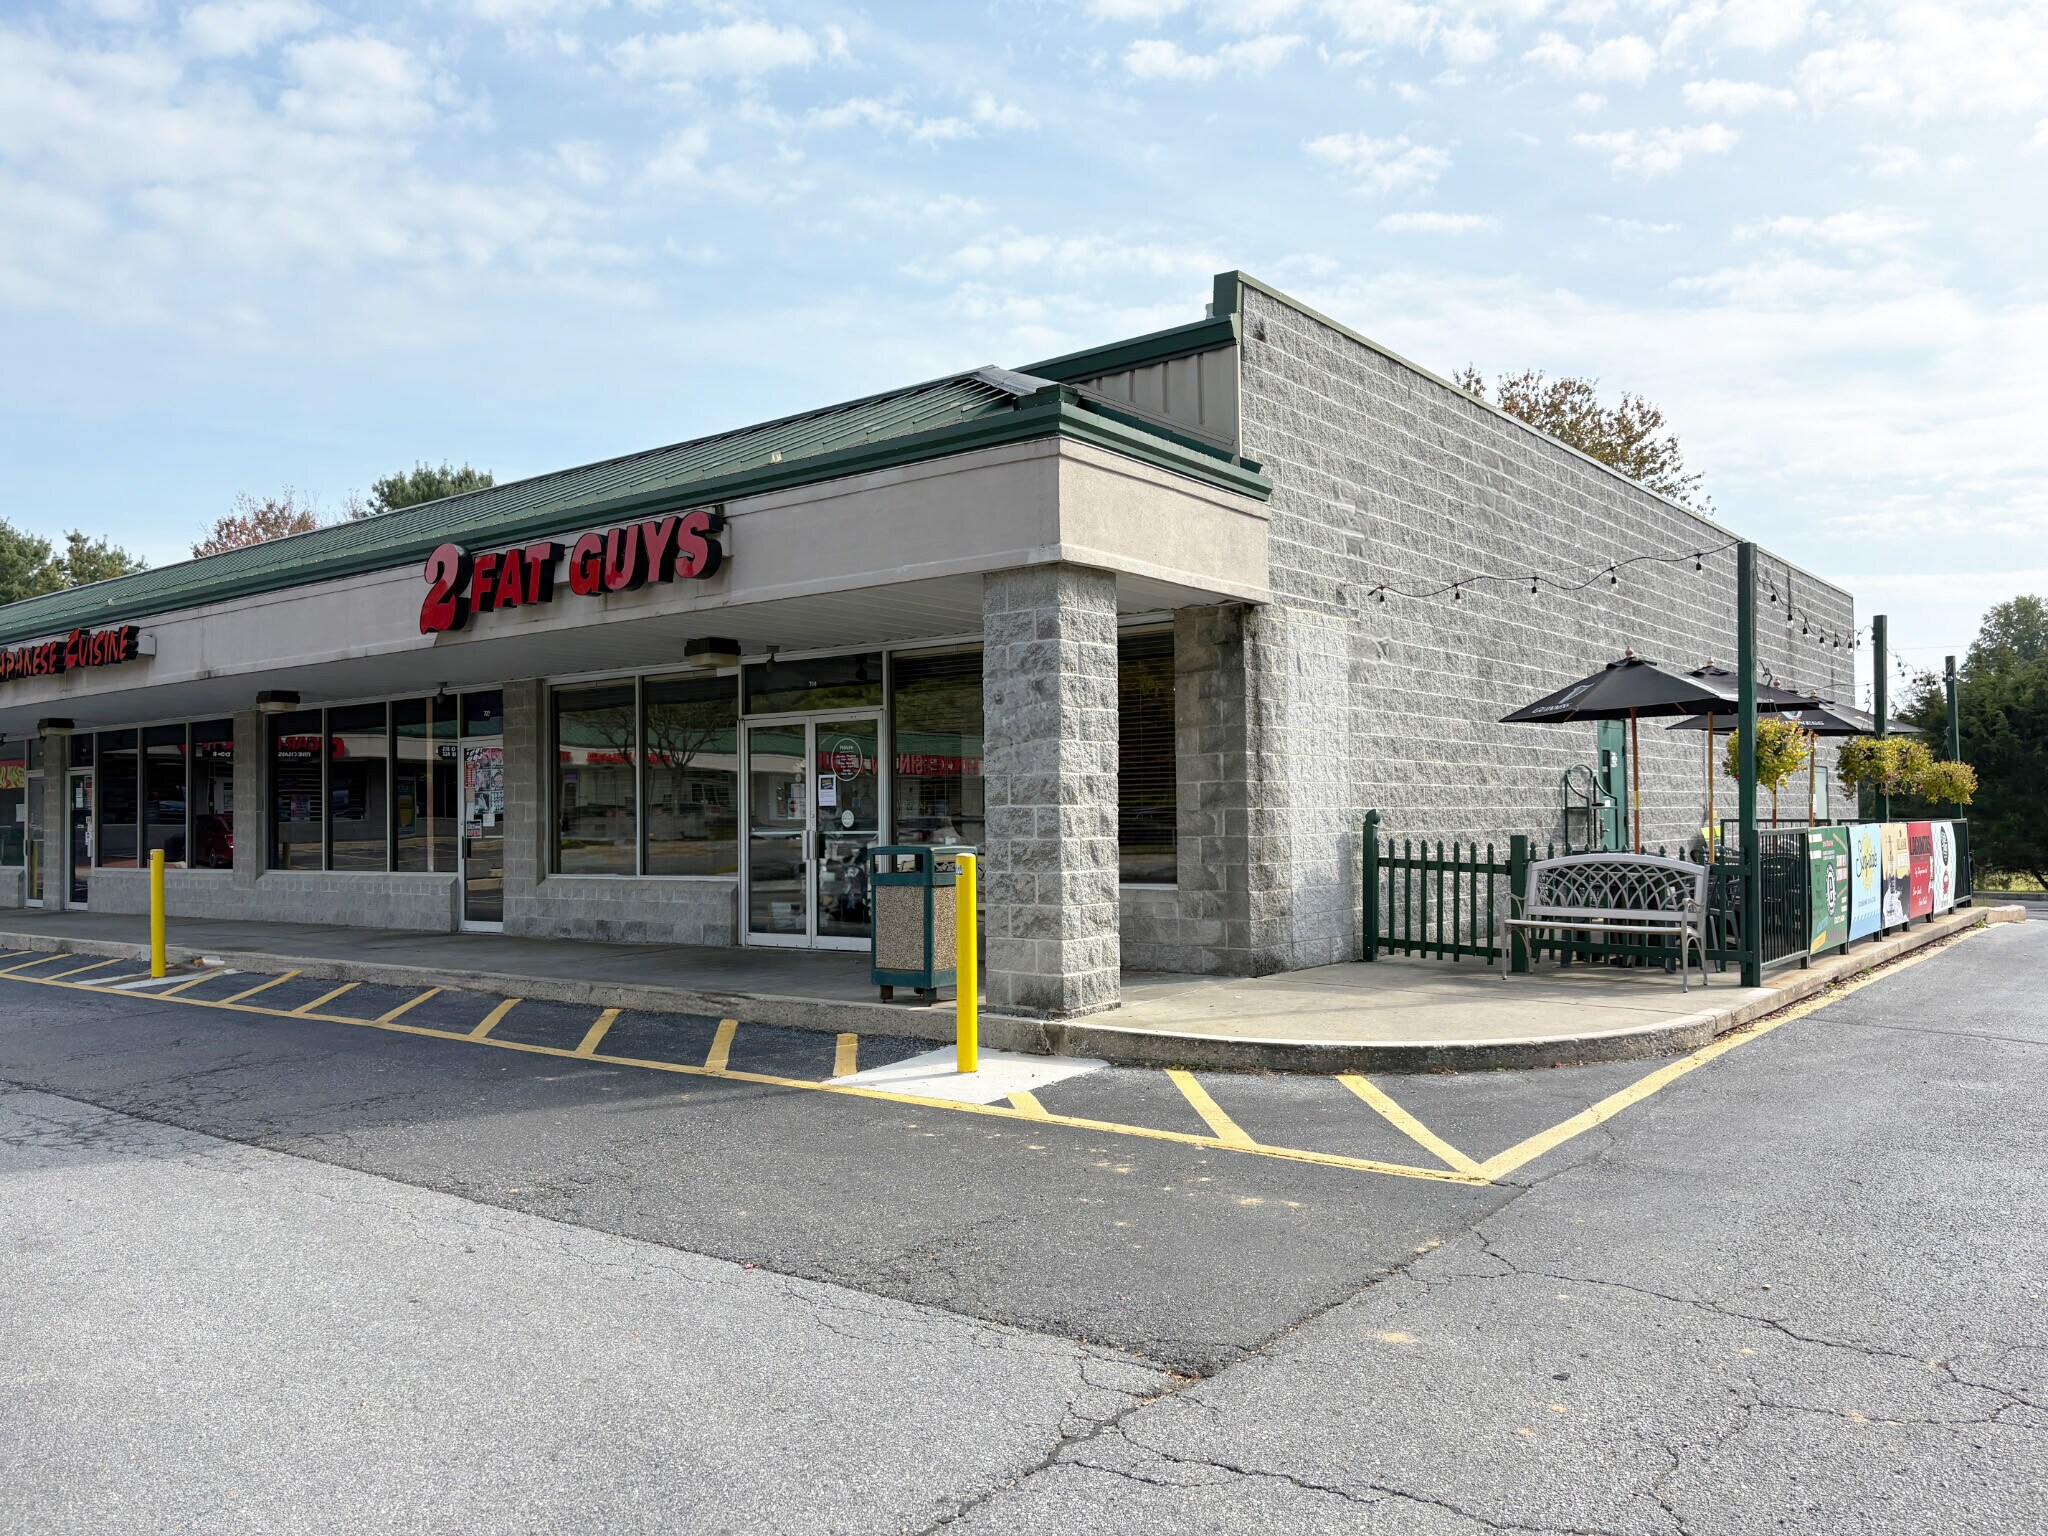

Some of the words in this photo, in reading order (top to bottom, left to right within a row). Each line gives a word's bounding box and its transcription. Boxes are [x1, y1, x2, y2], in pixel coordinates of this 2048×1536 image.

[419, 542, 461, 635] 2
[469, 542, 554, 613] FAT
[569, 511, 713, 596] GUYS
[0, 641, 59, 679] APANESE
[65, 625, 131, 669] CUISINE
